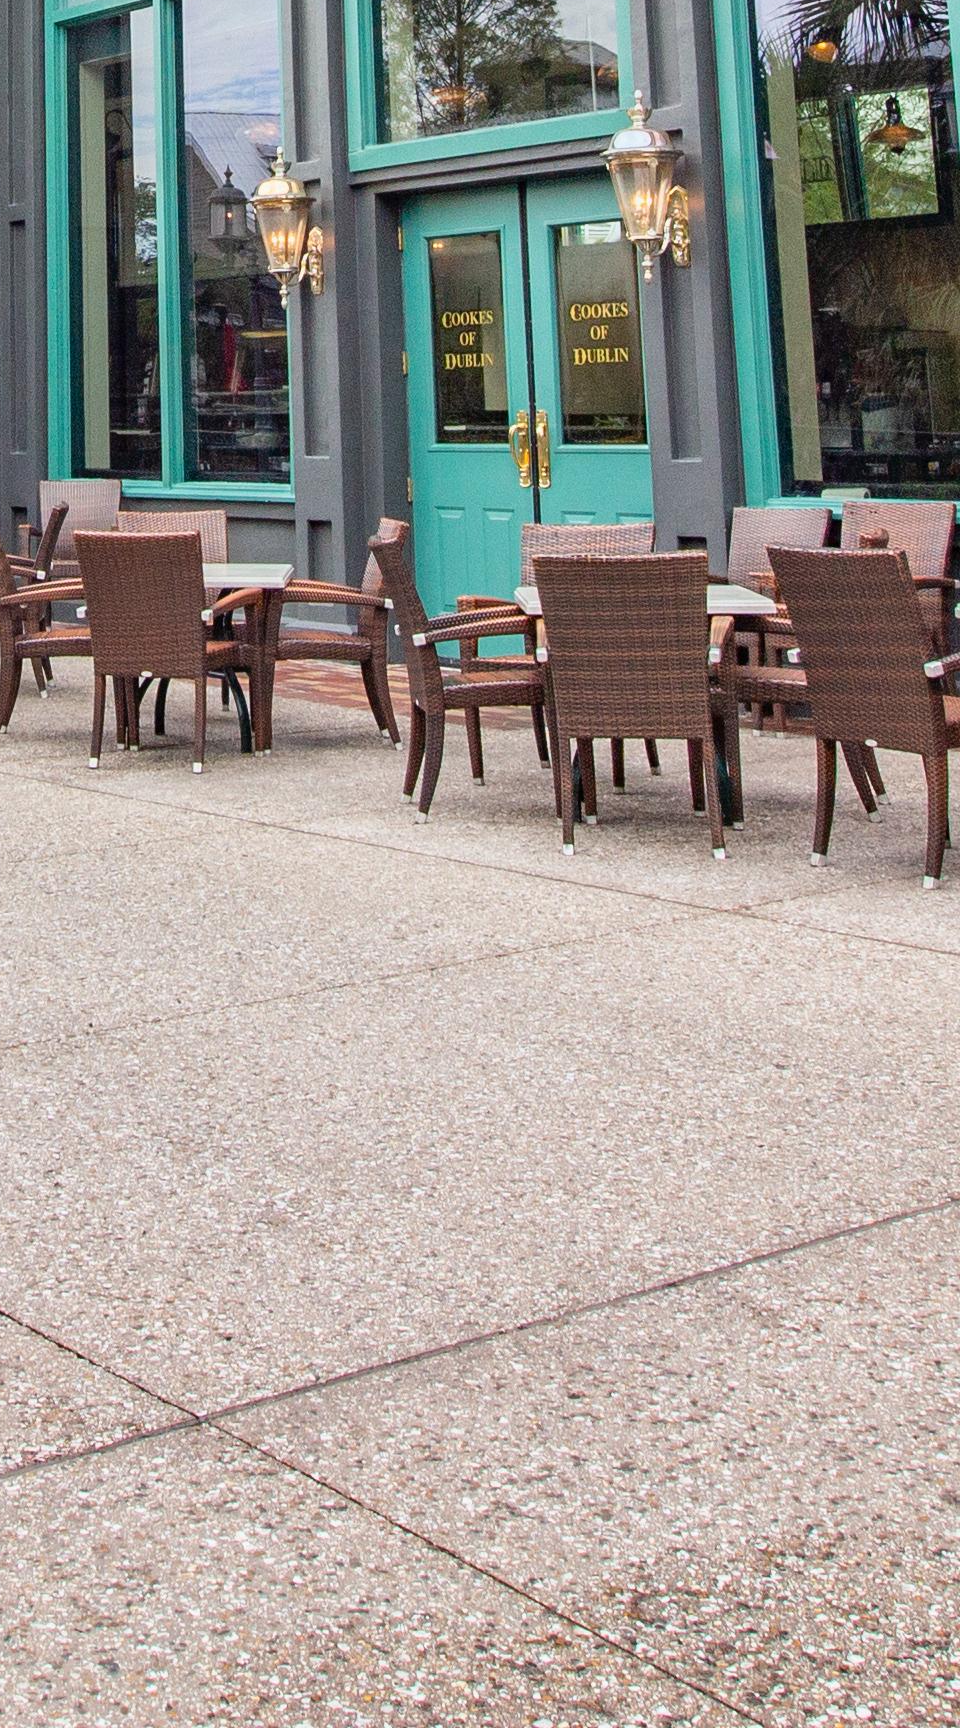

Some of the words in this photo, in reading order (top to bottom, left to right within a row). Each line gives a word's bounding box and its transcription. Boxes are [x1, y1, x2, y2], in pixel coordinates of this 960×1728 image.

[442, 310, 494, 329] COOKES
[570, 302, 629, 321] COOKES
[459, 331, 477, 346] OF
[590, 325, 609, 340] OF
[444, 352, 494, 370] DUBLIN
[572, 347, 629, 365] DUBLIN
